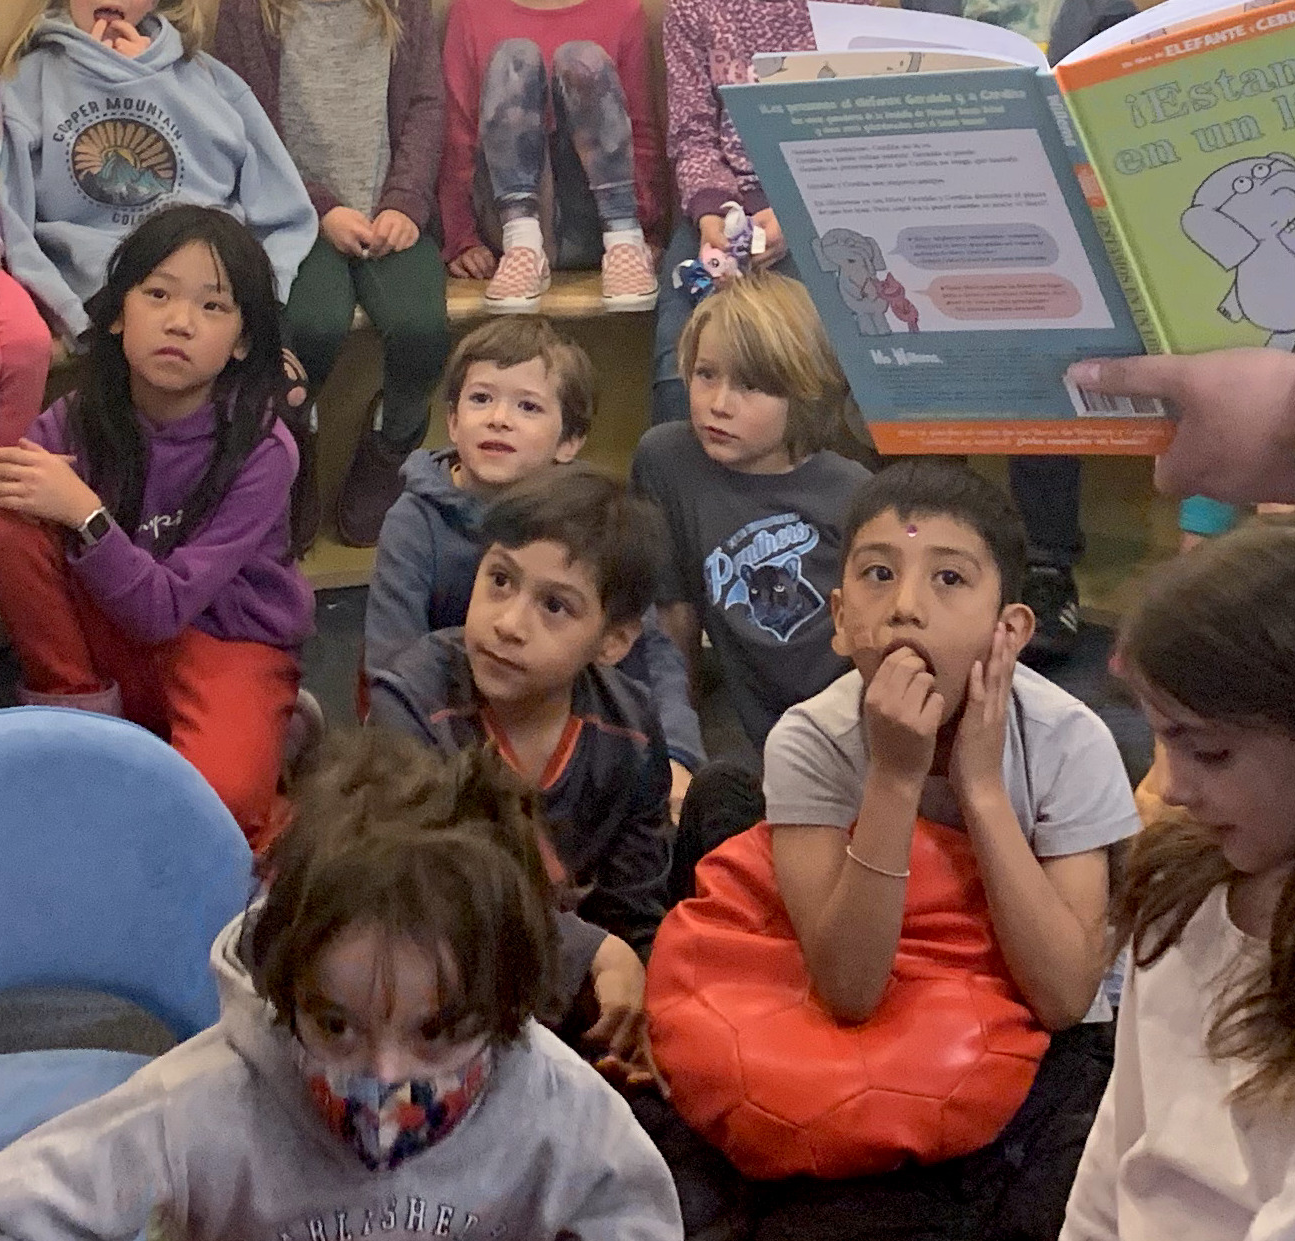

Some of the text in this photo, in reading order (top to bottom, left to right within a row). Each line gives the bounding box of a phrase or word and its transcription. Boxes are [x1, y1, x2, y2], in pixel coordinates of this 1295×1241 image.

[1164, 25, 1246, 57] ELEFANTE
[53, 96, 183, 142] COPPER MOUNTAIN
[1114, 138, 1181, 176] en
[1190, 114, 1266, 153] un
[704, 521, 812, 605] Panthers
